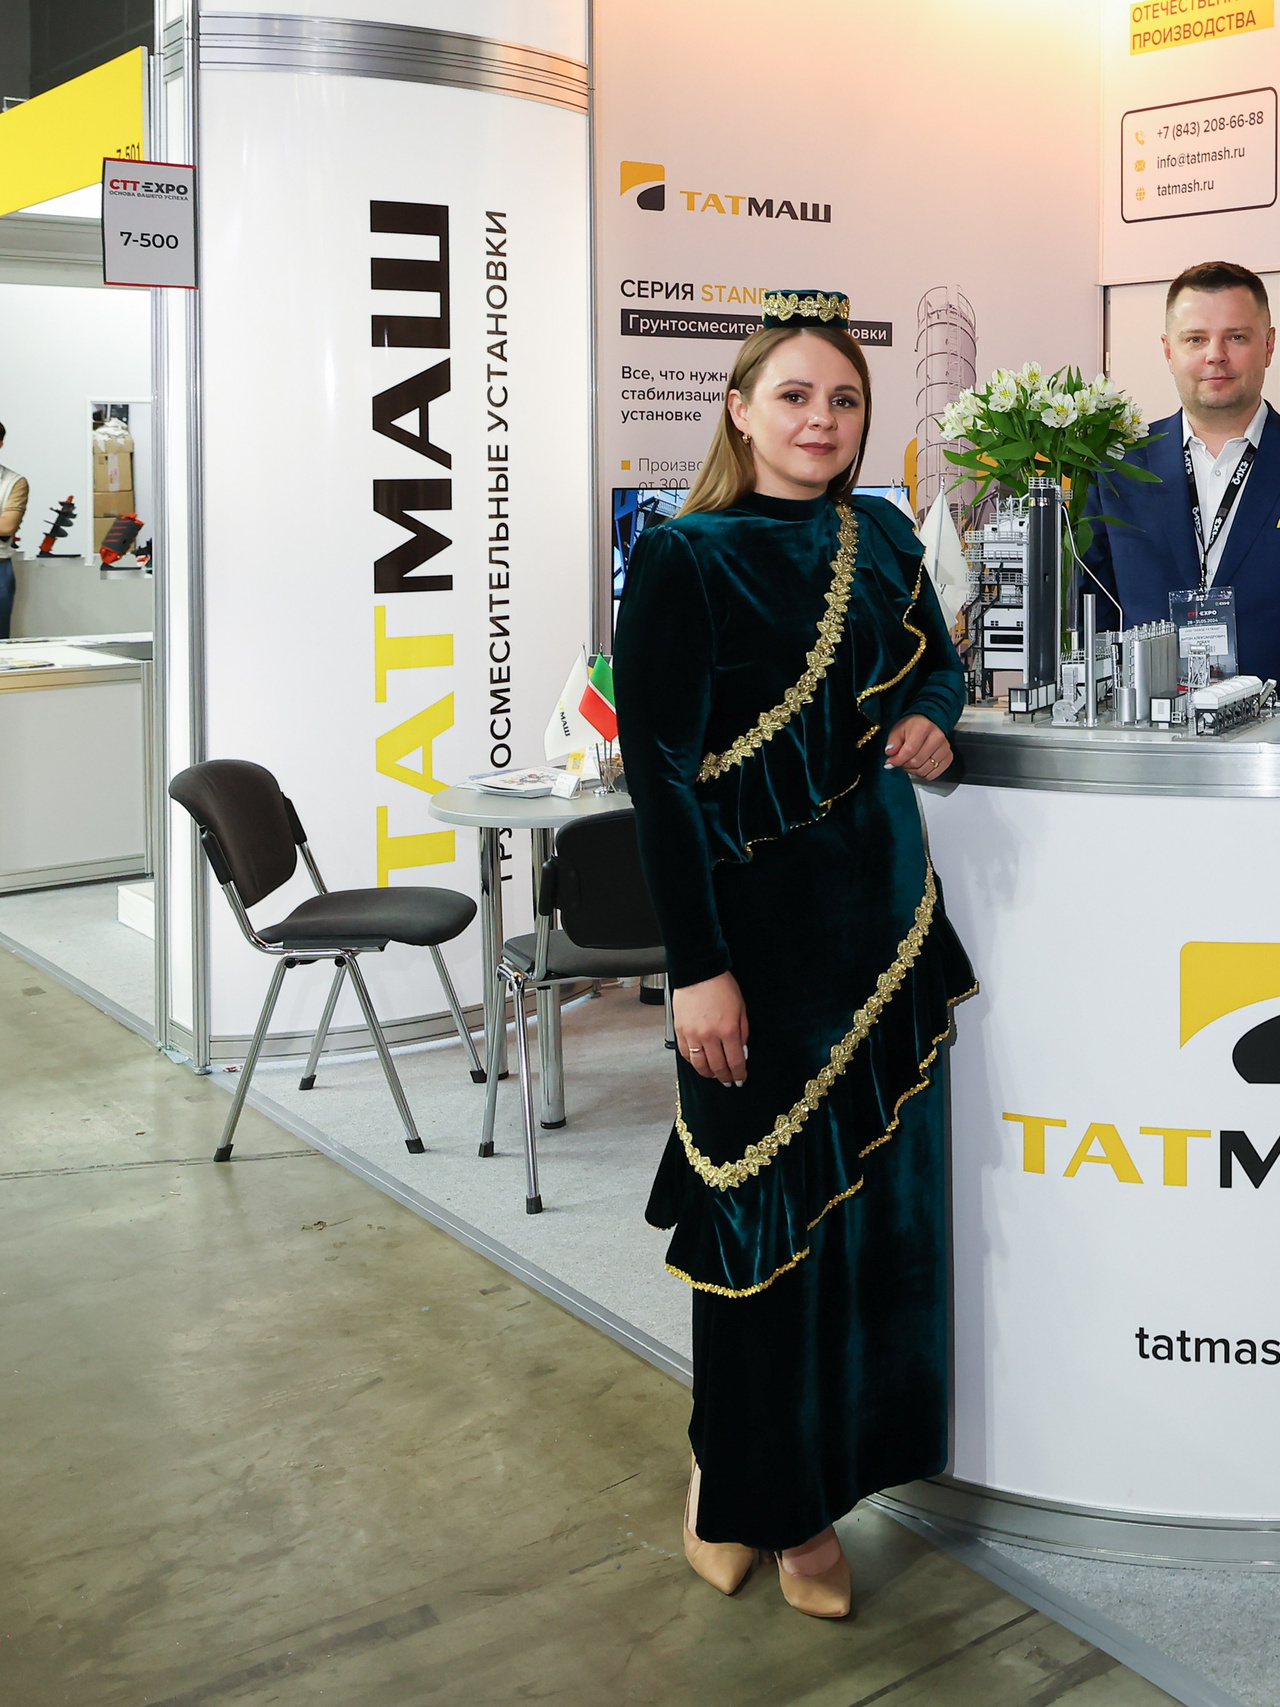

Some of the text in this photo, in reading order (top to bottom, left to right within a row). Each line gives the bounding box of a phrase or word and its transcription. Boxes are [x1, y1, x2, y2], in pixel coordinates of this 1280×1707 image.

[1132, 10, 1256, 50] ПРОИЗВОДСТВА
[1157, 111, 1264, 140] +7 (843) 208-66-88
[116, 142, 140, 160] 7501
[1157, 147, 1245, 169] info@tatmash.ru
[1157, 179, 1214, 197] tatmash.ru
[679, 190, 831, 223] ТАТМАШ
[120, 231, 179, 249] 7-500
[620, 279, 694, 301] СЕРИЯ
[485, 210, 509, 432] УСТАНОВКИ
[621, 366, 730, 385] Все, что нужн
[621, 387, 726, 403] стабилизаци
[621, 410, 702, 424] установке
[370, 200, 455, 888] ТАТМАШ
